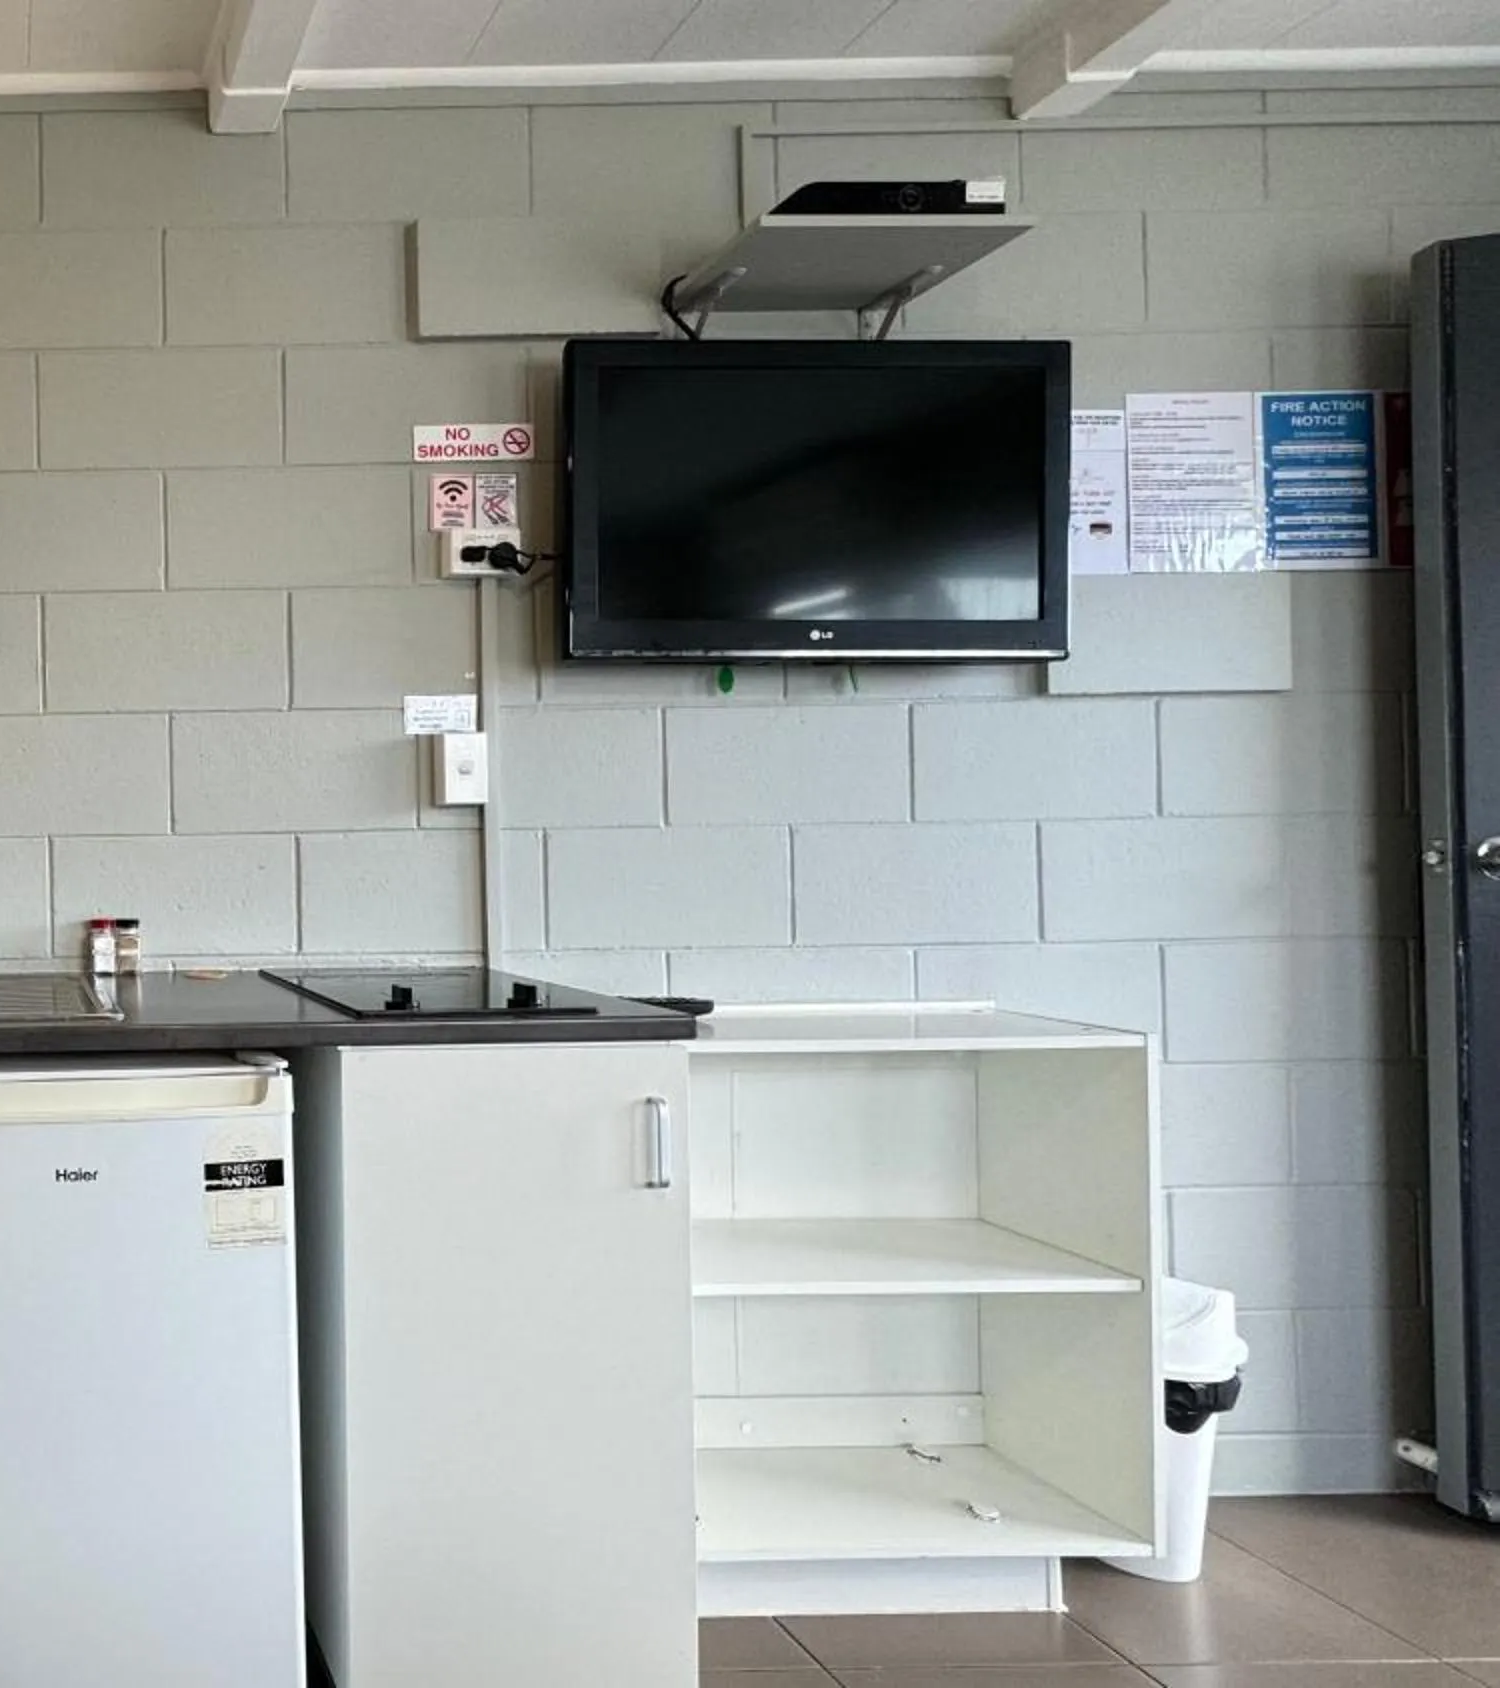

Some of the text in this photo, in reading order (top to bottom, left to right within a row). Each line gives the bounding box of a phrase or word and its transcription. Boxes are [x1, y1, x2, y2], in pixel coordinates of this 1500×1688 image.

[1270, 399, 1366, 413] FIRE ACTION
[1291, 414, 1349, 427] NOTICE
[445, 427, 471, 440] NO
[417, 444, 499, 458] SMOKING
[55, 1167, 99, 1182] Haier
[219, 1163, 267, 1176] ENERGY
[221, 1175, 267, 1188] RATING
